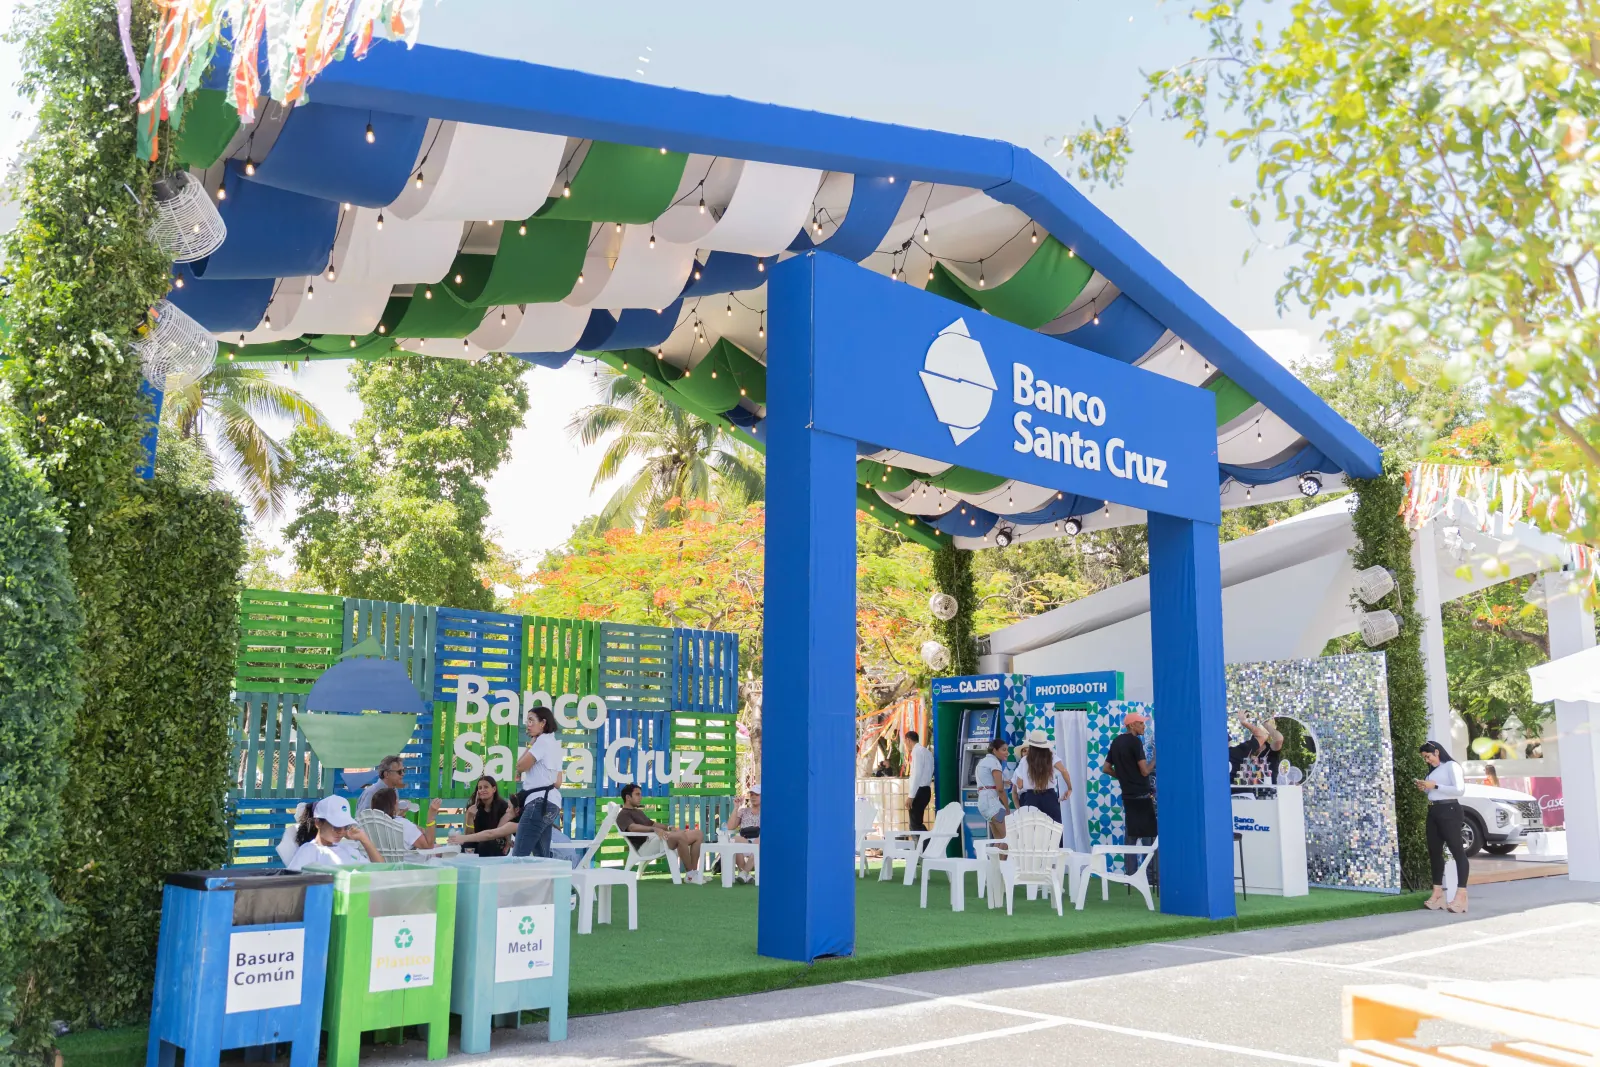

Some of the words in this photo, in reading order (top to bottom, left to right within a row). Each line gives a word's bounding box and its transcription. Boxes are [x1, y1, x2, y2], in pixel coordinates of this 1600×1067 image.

[1013, 362, 1106, 426] Banco
[1013, 411, 1101, 471] Santa
[1105, 437, 1168, 488] Cruz
[959, 679, 1000, 693] CAJERO
[1035, 682, 1108, 696] PHOTOBOOTH
[604, 737, 704, 784] Cruz
[1234, 823, 1253, 831] Santa
[508, 938, 543, 954] Metal
[236, 951, 295, 967] Basura
[233, 967, 295, 986] Común
